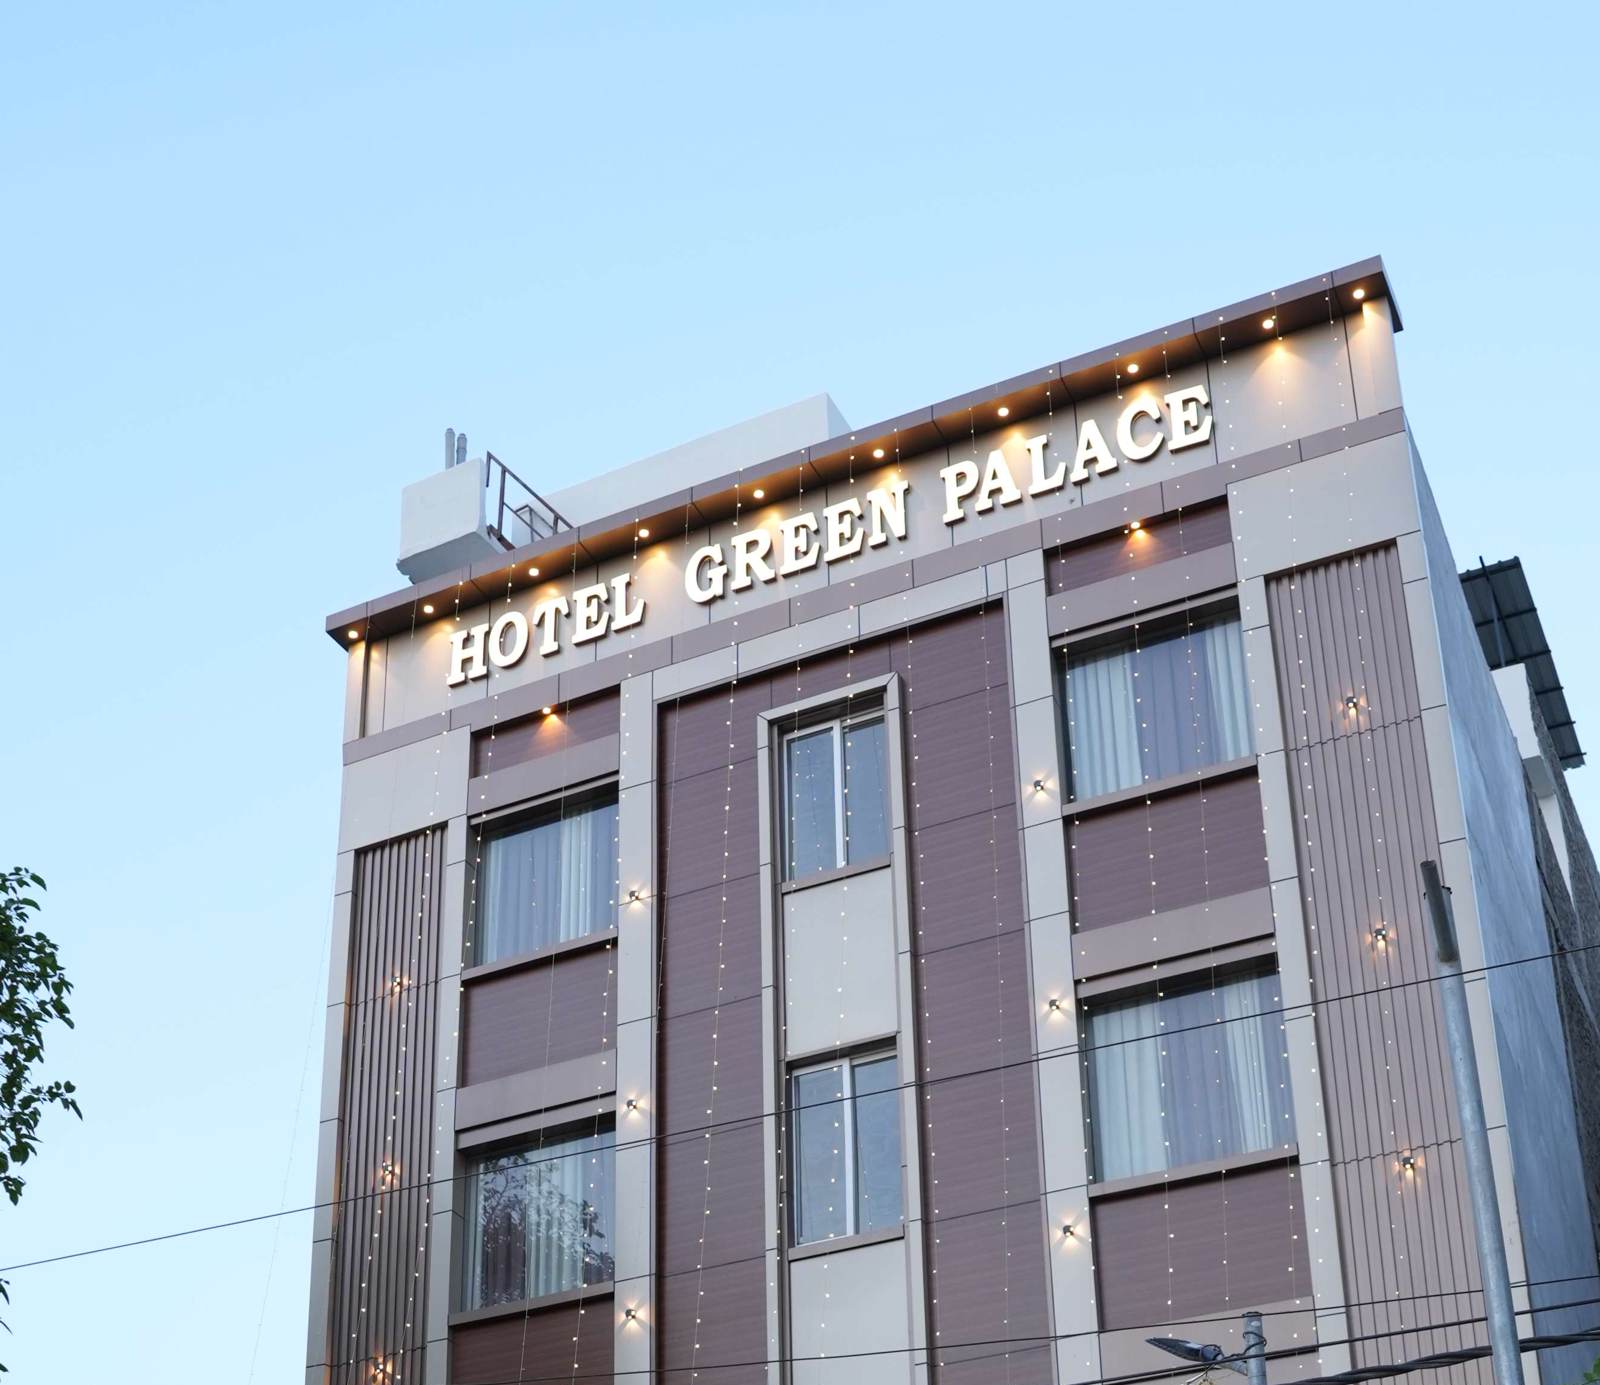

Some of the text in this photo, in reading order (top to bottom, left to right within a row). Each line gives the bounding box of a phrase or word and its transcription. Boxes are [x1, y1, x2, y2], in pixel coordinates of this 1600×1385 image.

[446, 384, 1213, 687] HOTEL GREEN PALACE
